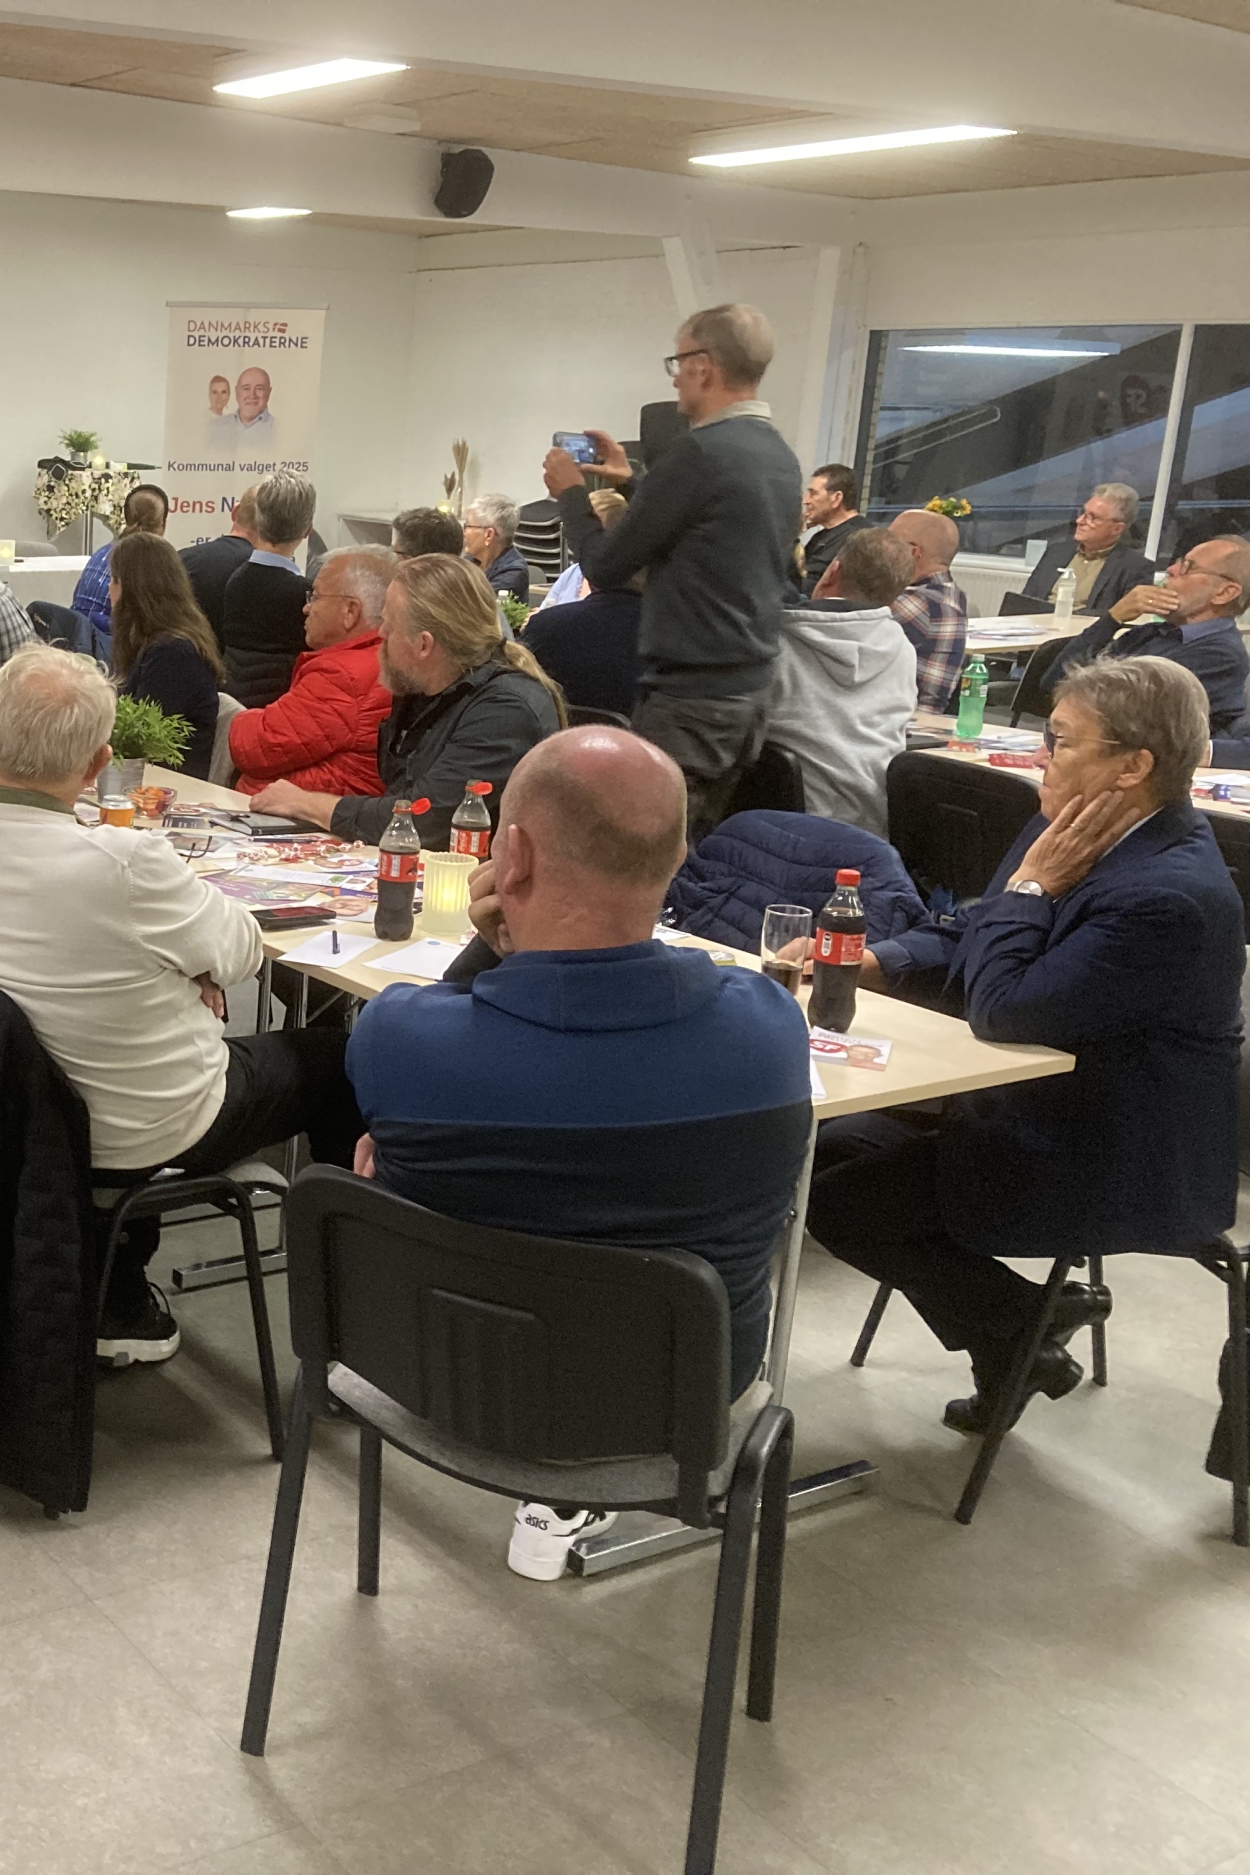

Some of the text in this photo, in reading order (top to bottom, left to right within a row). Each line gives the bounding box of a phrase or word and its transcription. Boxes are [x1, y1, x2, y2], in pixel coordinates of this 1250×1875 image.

[187, 320, 270, 334] DANMARKS
[186, 335, 309, 349] DEMOKRATERNE
[167, 461, 309, 474] Kommunal valget 2025
[168, 497, 215, 513] Jens
[810, 1041, 841, 1051] SF
[525, 1514, 549, 1530] asics
